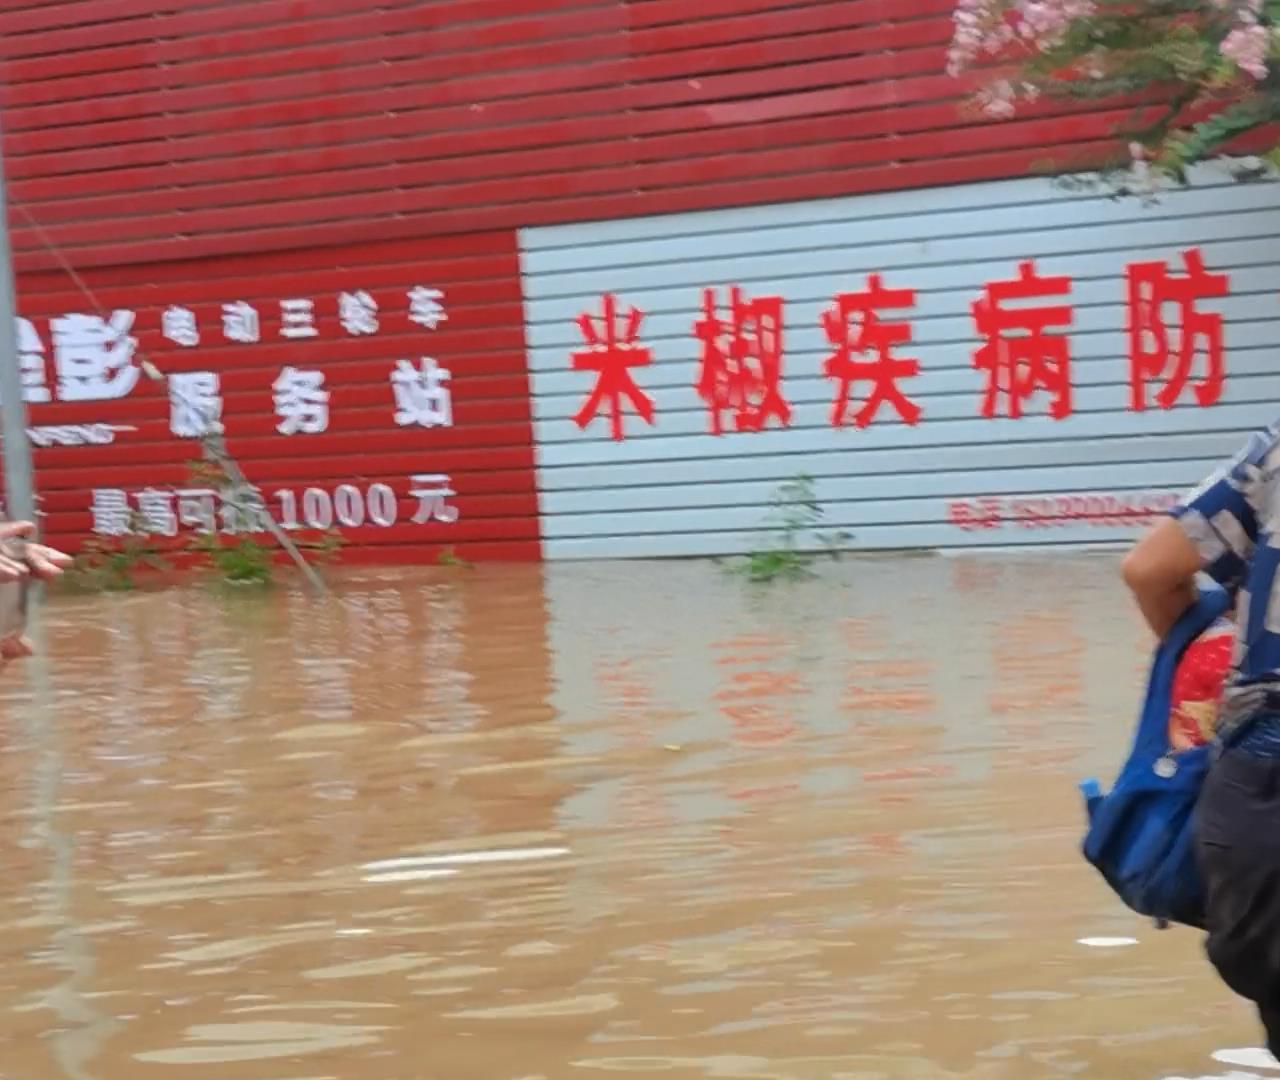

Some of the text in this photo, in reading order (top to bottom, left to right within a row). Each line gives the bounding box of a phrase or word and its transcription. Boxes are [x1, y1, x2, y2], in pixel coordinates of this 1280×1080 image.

[162, 285, 448, 346] 电动三轮车
[169, 357, 454, 438] 服务站
